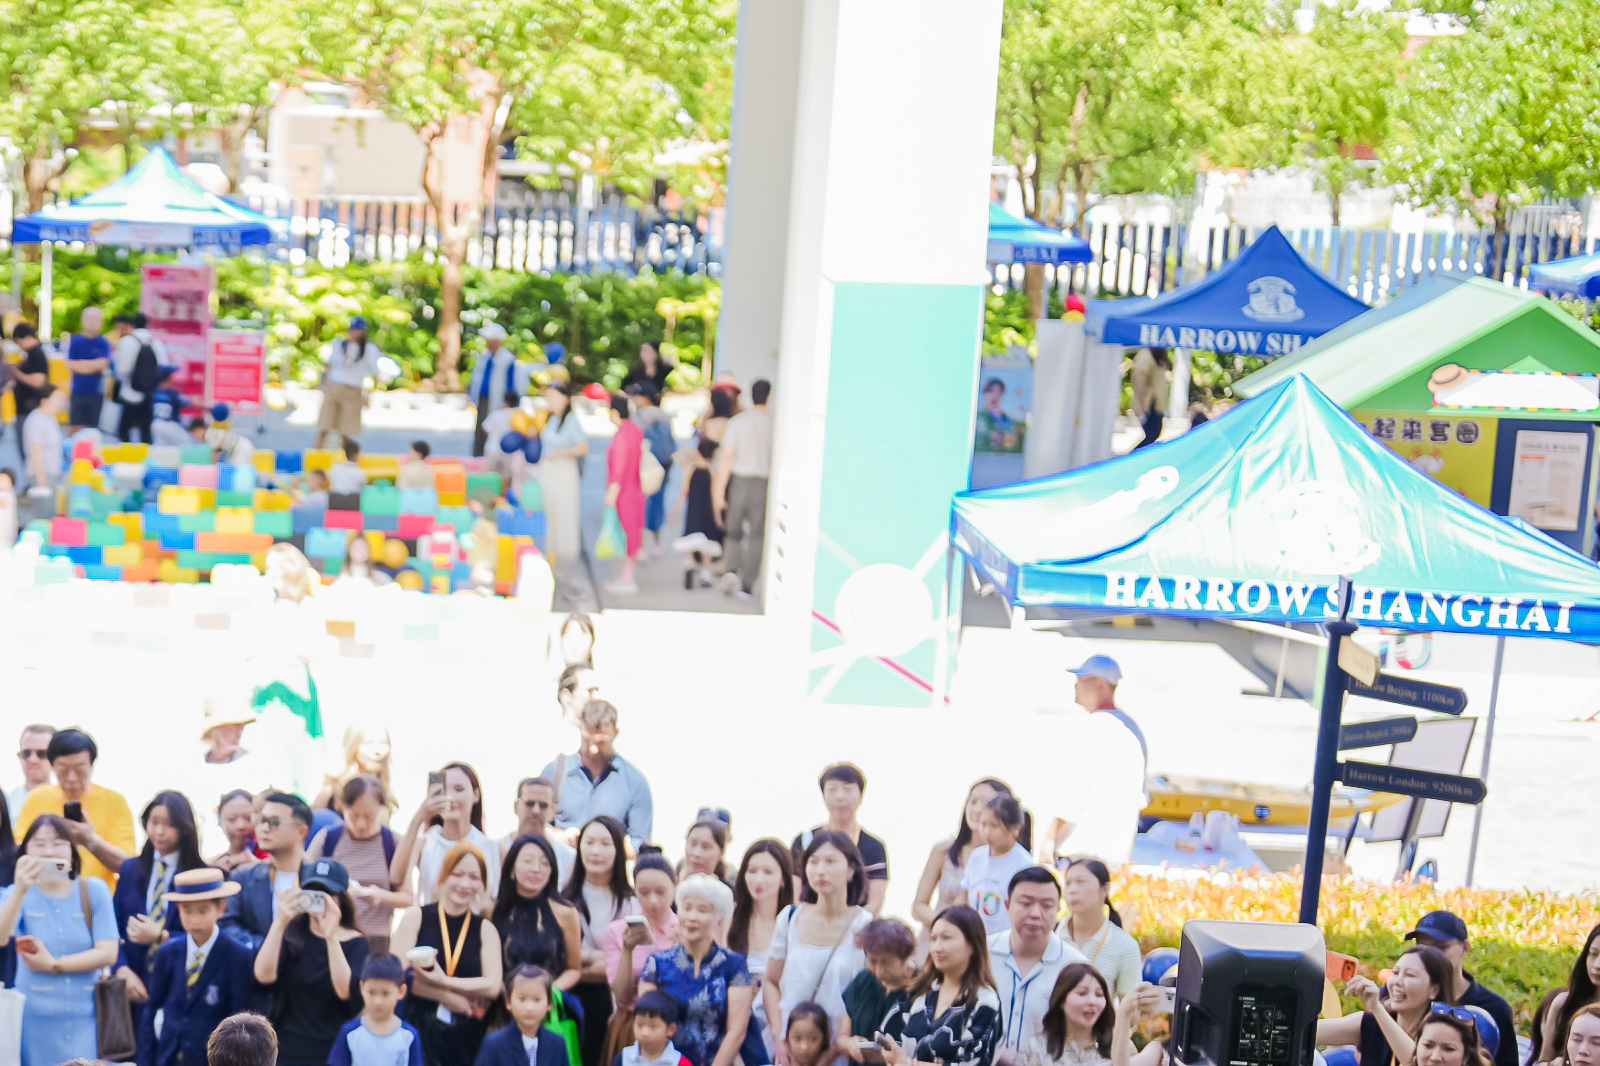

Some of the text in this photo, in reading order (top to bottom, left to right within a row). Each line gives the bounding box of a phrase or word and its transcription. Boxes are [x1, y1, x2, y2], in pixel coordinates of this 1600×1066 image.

[1140, 324, 1263, 353] HARROW
[1104, 573, 1317, 616] HARROW
[1349, 769, 1384, 782] Harrow
[1432, 781, 1473, 797] 9200km
